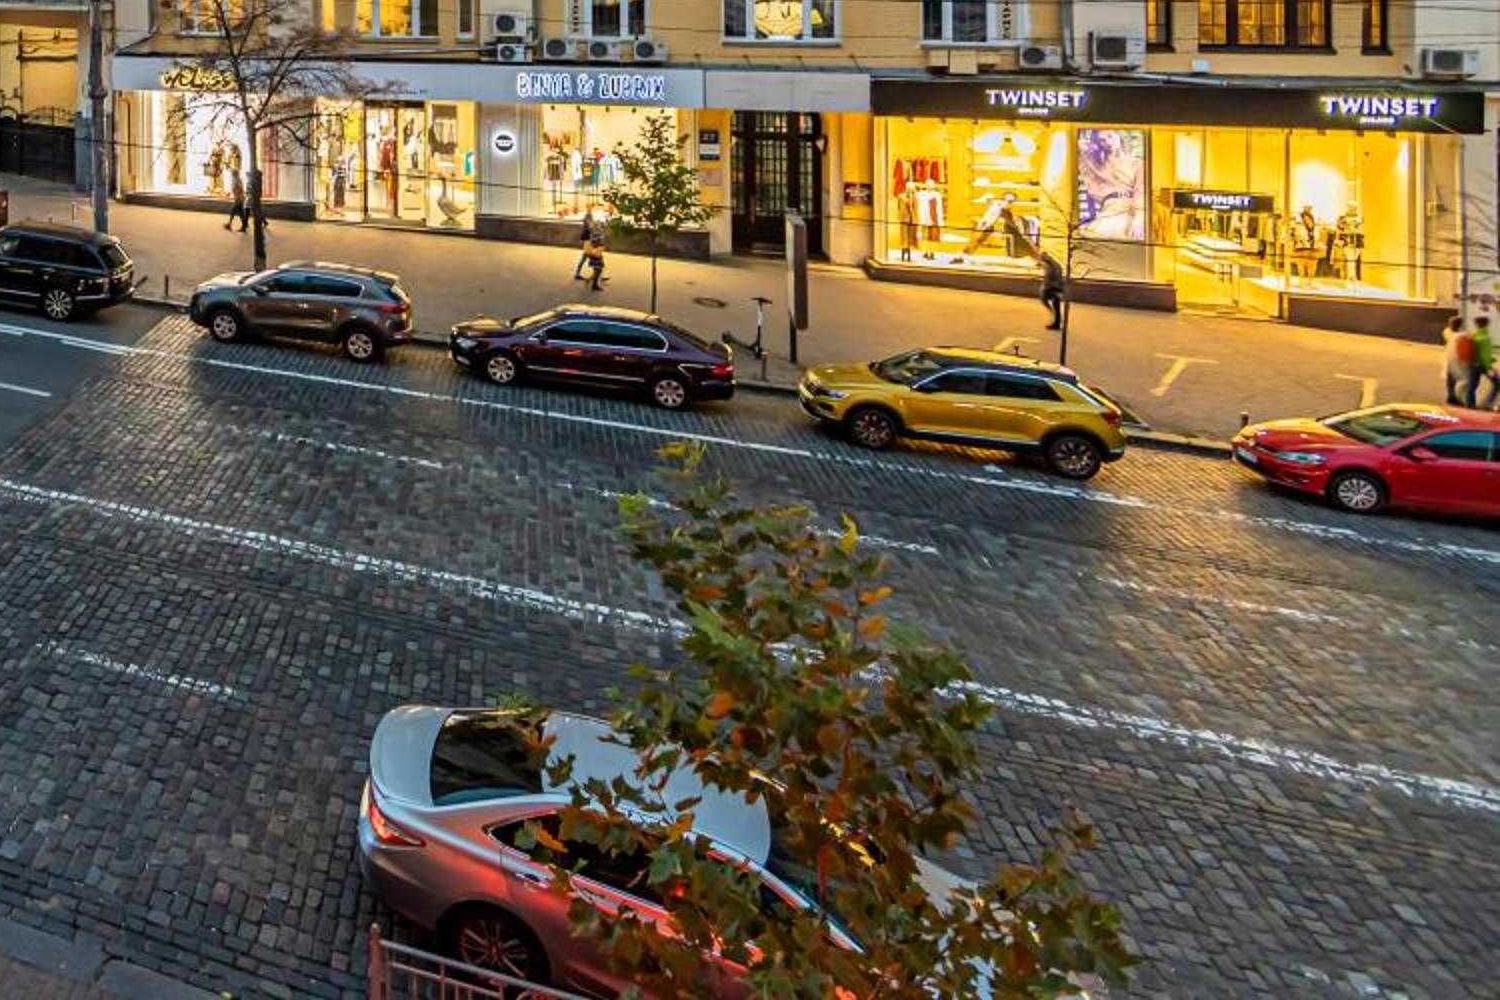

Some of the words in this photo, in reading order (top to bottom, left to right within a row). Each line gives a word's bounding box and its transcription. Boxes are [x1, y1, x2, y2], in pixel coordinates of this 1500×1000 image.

[985, 88, 1086, 108] TWINSET
[1320, 95, 1438, 117] TWINSET
[1191, 193, 1252, 206] TWINSET
